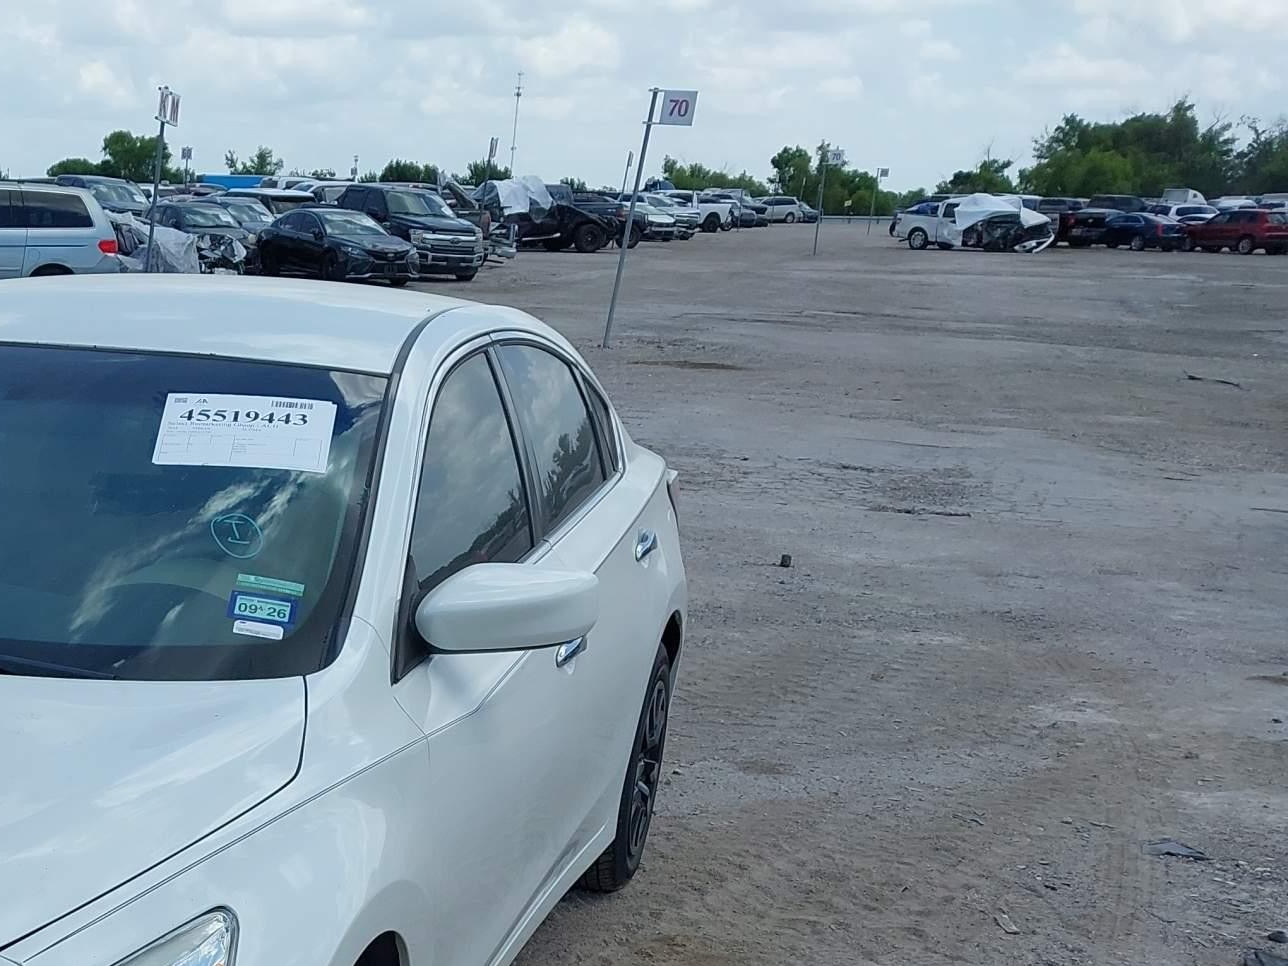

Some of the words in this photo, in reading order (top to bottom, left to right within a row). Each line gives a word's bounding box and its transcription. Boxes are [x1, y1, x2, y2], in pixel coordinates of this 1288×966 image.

[668, 99, 690, 118] 70
[831, 152, 842, 161] 70
[179, 408, 309, 426] 45519443
[238, 602, 258, 614] 09
[266, 606, 288, 619] 26
